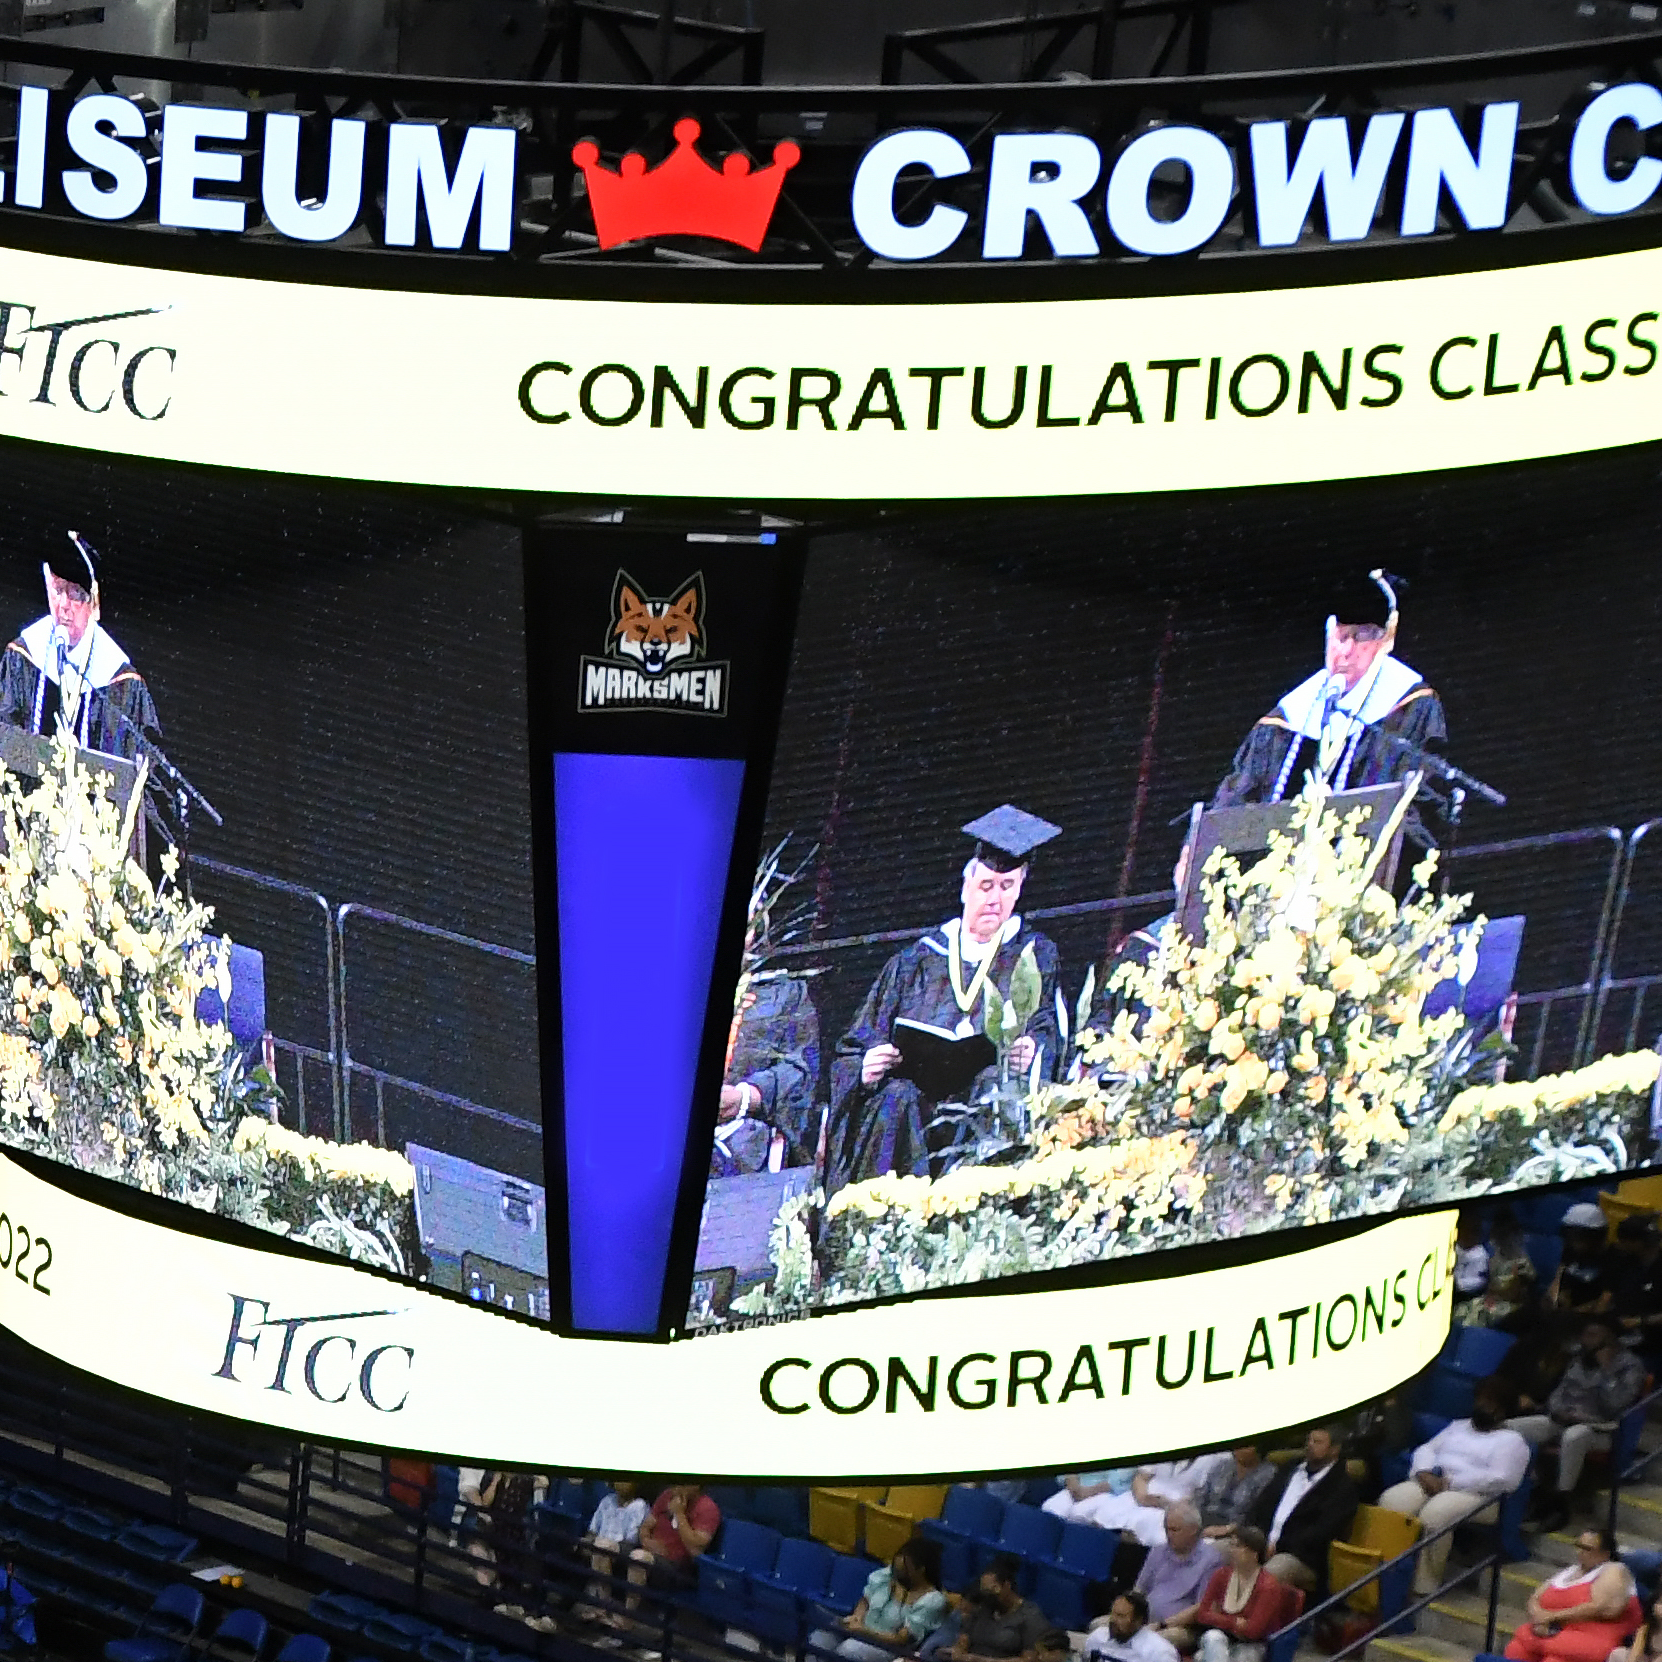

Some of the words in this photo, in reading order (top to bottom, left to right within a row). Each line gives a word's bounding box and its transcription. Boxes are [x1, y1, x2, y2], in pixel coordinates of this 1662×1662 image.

[851, 101, 1519, 261] CROWN
[518, 343, 1404, 431] CONGRATULATIONS
[1429, 311, 1660, 401] CLASS
[585, 664, 722, 710] MARKSMEN
[212, 1292, 414, 1412] FTCC
[760, 1269, 1407, 1415] CONGRATULATIONS
